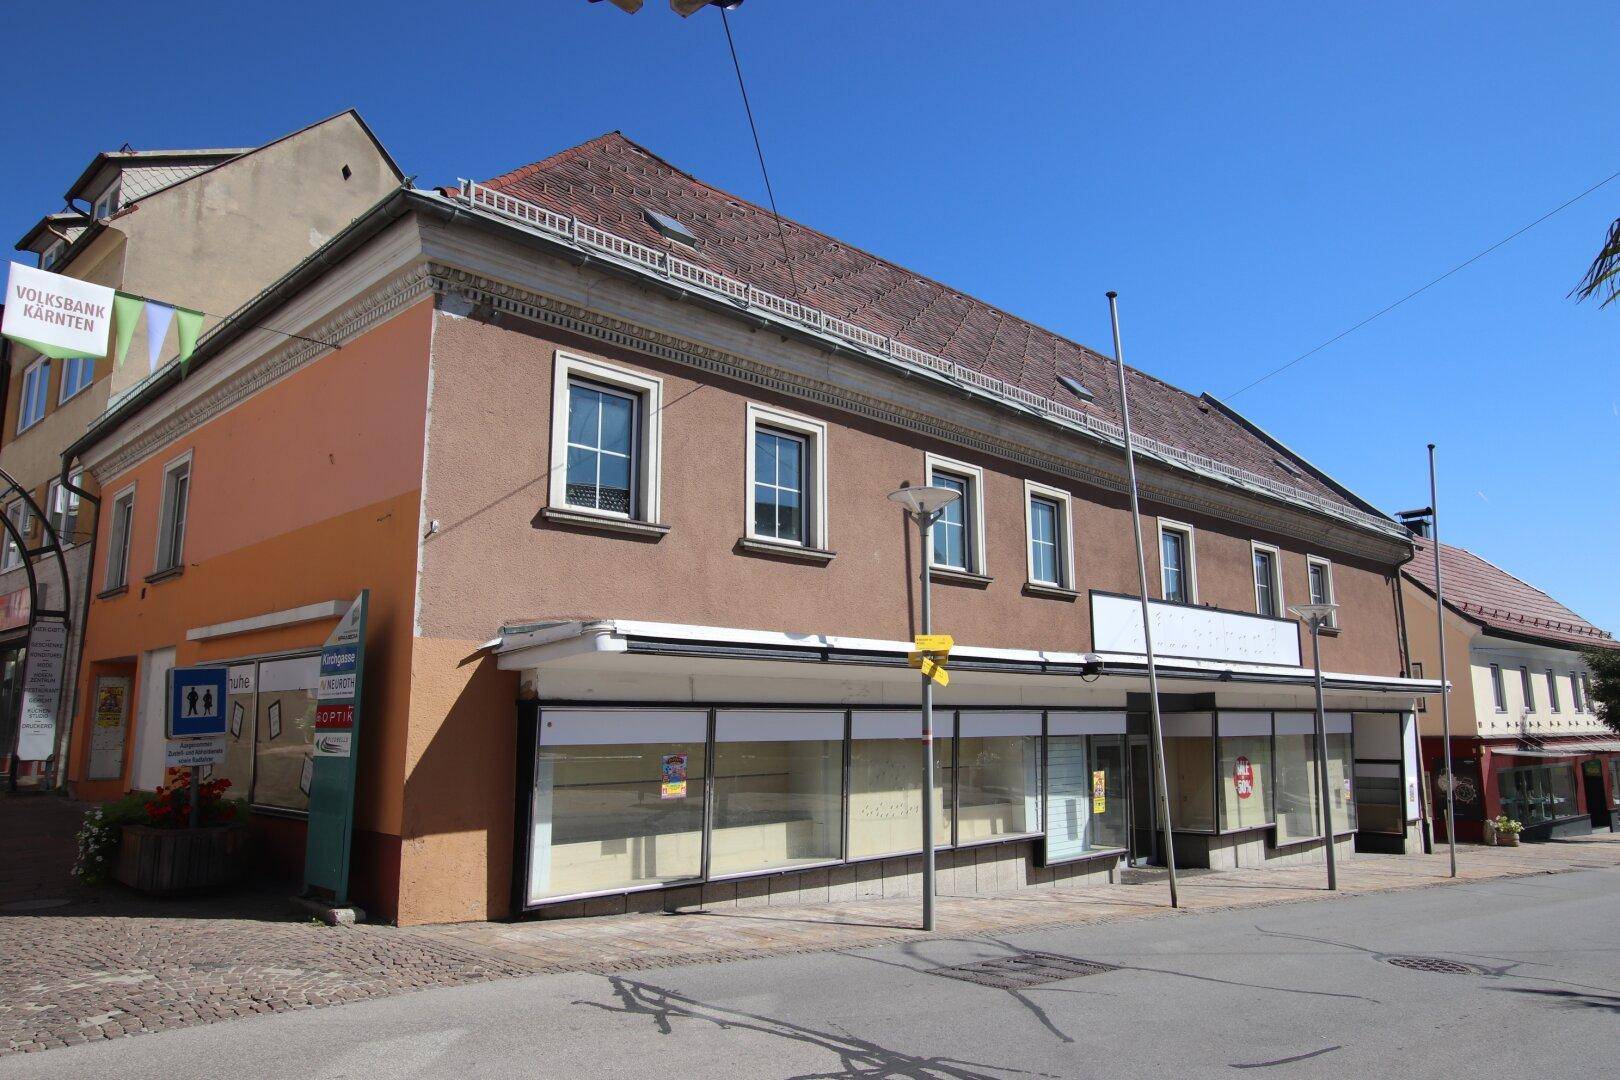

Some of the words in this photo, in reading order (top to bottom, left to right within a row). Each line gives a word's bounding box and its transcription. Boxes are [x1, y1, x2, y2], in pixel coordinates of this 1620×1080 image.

[16, 285, 105, 319] VOLKSBANK
[23, 303, 95, 332] KÄRNTEN
[322, 652, 356, 667] Kirchgasse
[327, 678, 355, 690] NEUROTH
[322, 711, 353, 723] OPTIK
[1236, 760, 1250, 776] SALE
